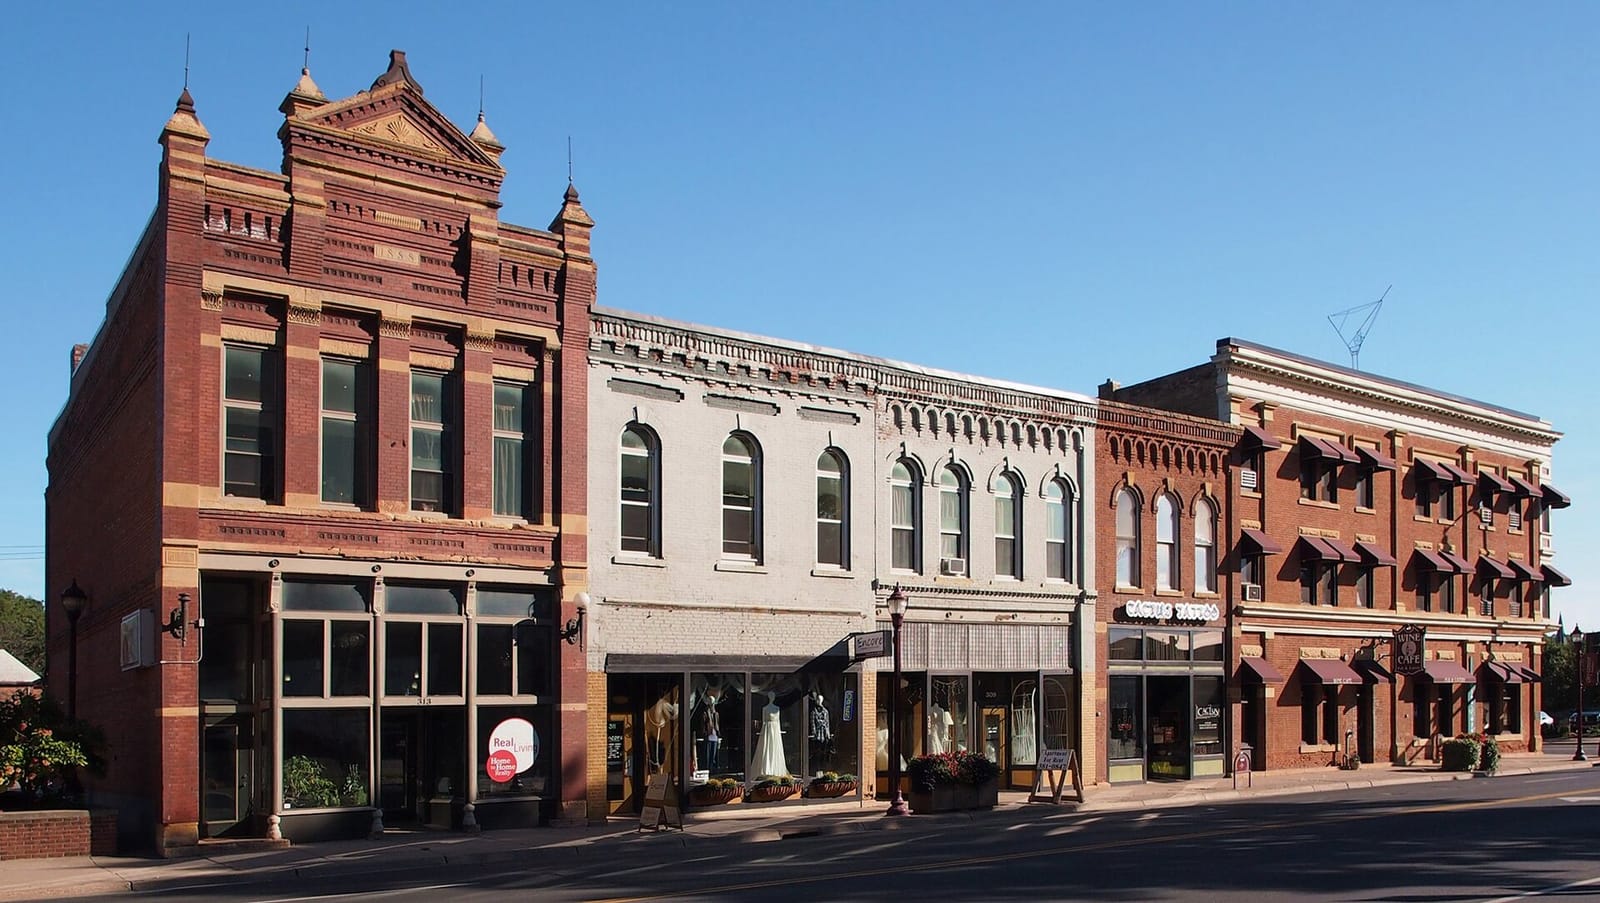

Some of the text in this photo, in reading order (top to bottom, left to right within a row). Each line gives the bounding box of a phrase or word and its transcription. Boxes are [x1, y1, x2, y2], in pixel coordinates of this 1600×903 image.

[1126, 600, 1219, 620] CACTUS TATTOO
[857, 637, 882, 648] Encore
[1398, 633, 1420, 642] WINE
[1398, 655, 1420, 664] CAFE
[494, 737, 538, 753] Real Living
